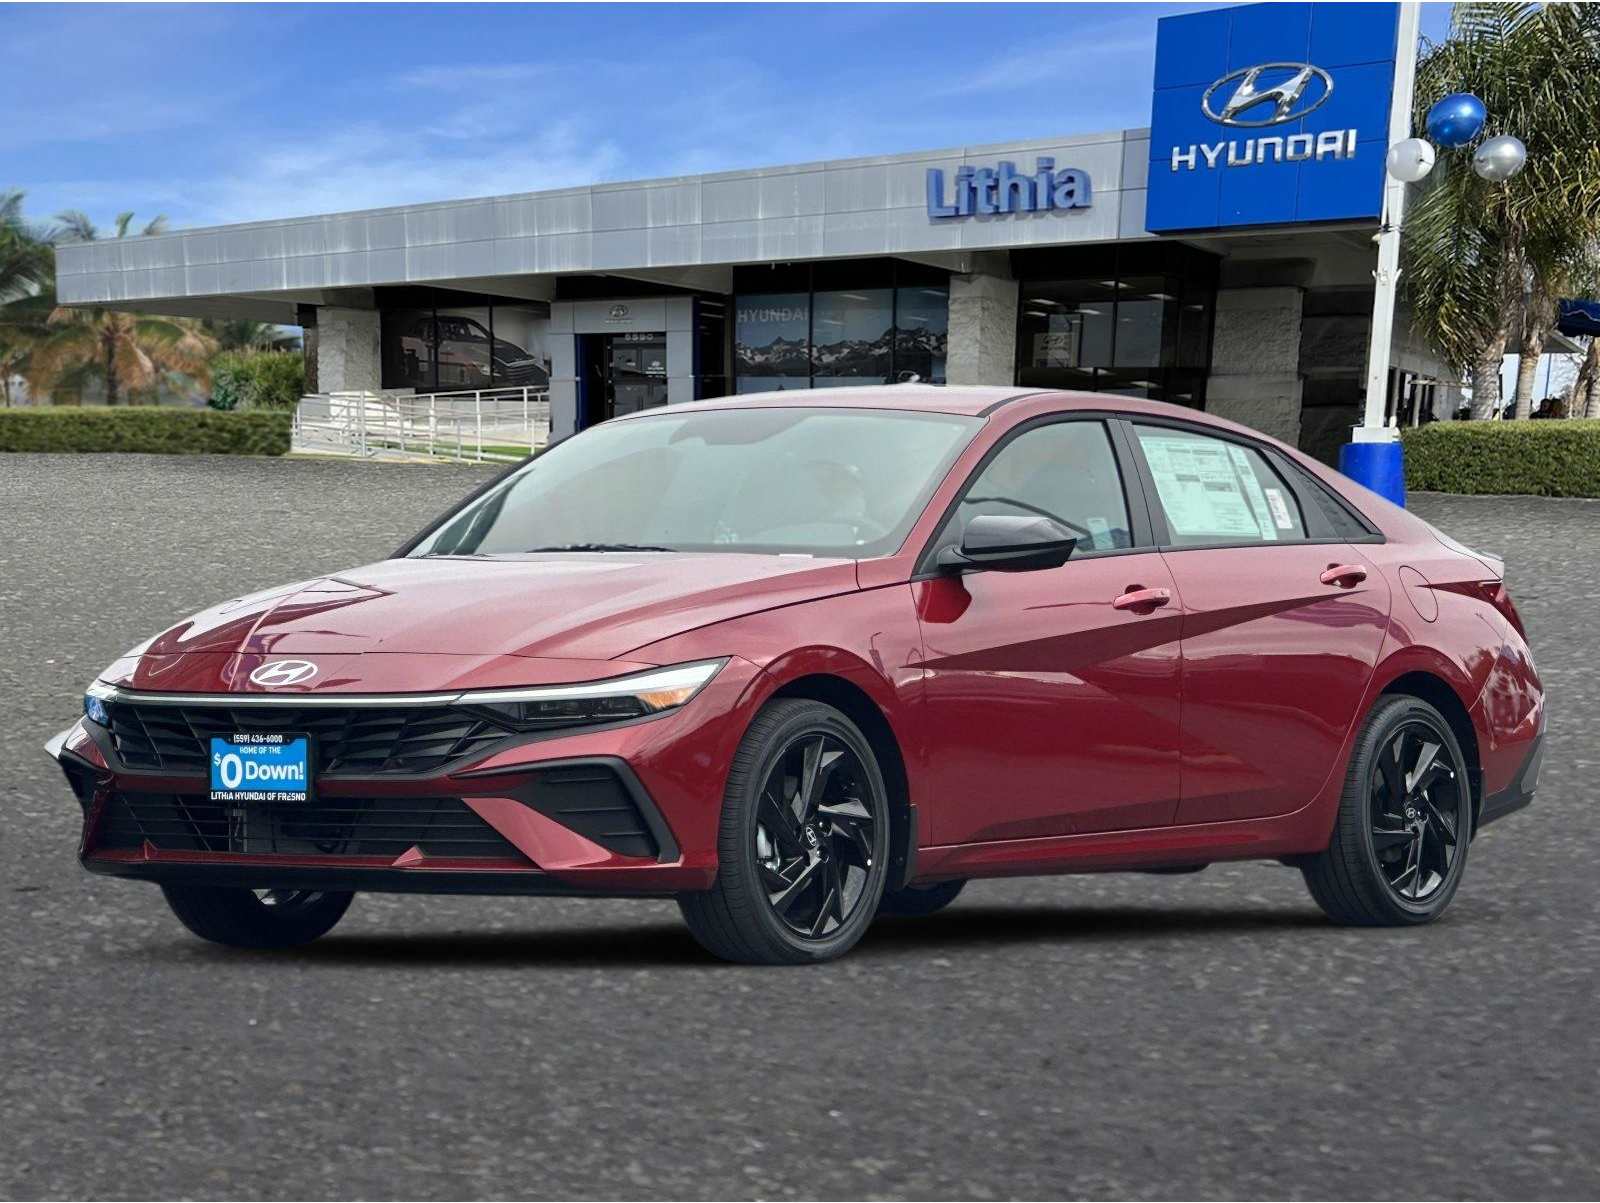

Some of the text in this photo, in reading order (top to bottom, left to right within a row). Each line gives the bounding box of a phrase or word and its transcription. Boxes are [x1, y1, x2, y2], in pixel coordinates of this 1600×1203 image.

[1171, 128, 1357, 172] HYUNDAI
[926, 156, 1092, 218] Lithia
[737, 307, 809, 324] HYUNDAI
[233, 734, 283, 743] (559) 436-6000
[240, 746, 281, 754] HOME OF THE
[245, 761, 304, 780] Down!
[211, 792, 306, 801] LITHIA HYUNDAI OF FRESNO
